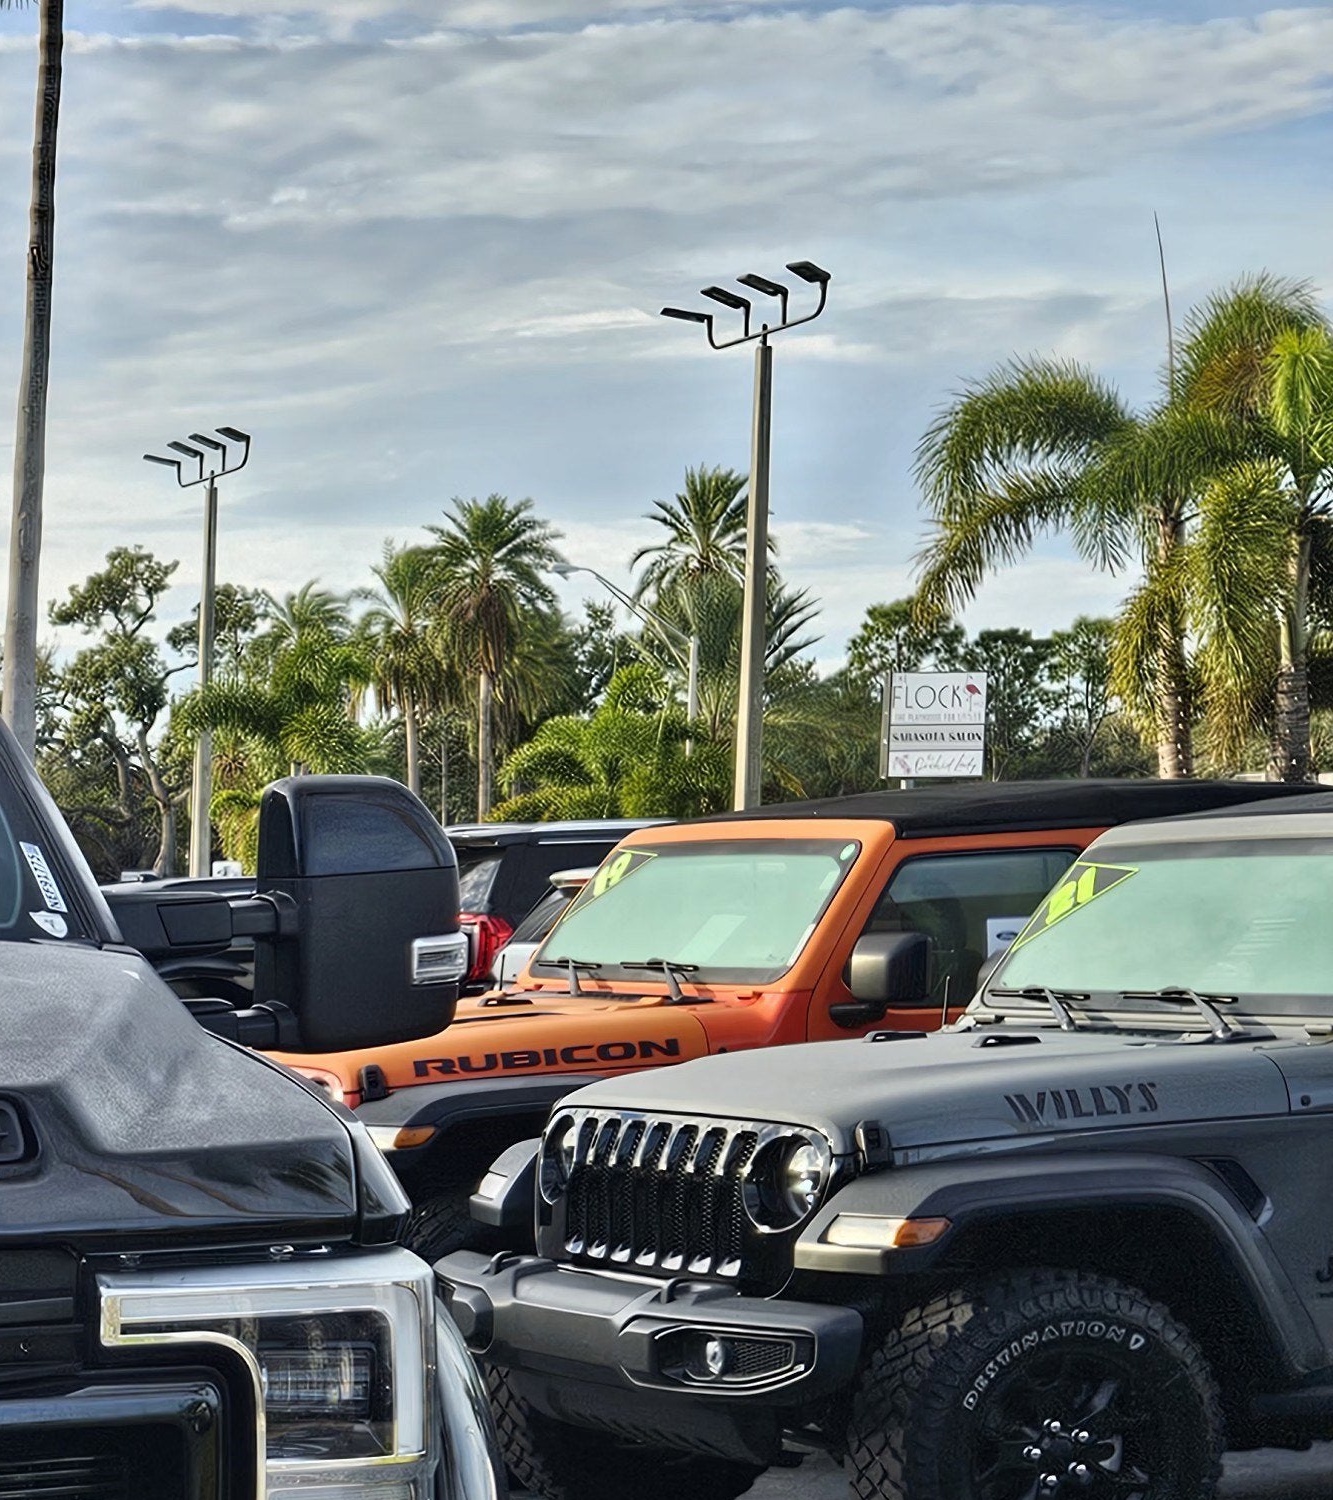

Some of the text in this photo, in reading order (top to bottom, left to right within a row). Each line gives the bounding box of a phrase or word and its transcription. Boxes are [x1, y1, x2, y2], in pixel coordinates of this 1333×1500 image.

[893, 684, 962, 709] FLOCK
[1045, 866, 1096, 925] 21
[413, 1038, 680, 1078] RUBICON
[1003, 1082, 1158, 1128] WILLYS
[963, 1321, 1126, 1411] DESTINATION
